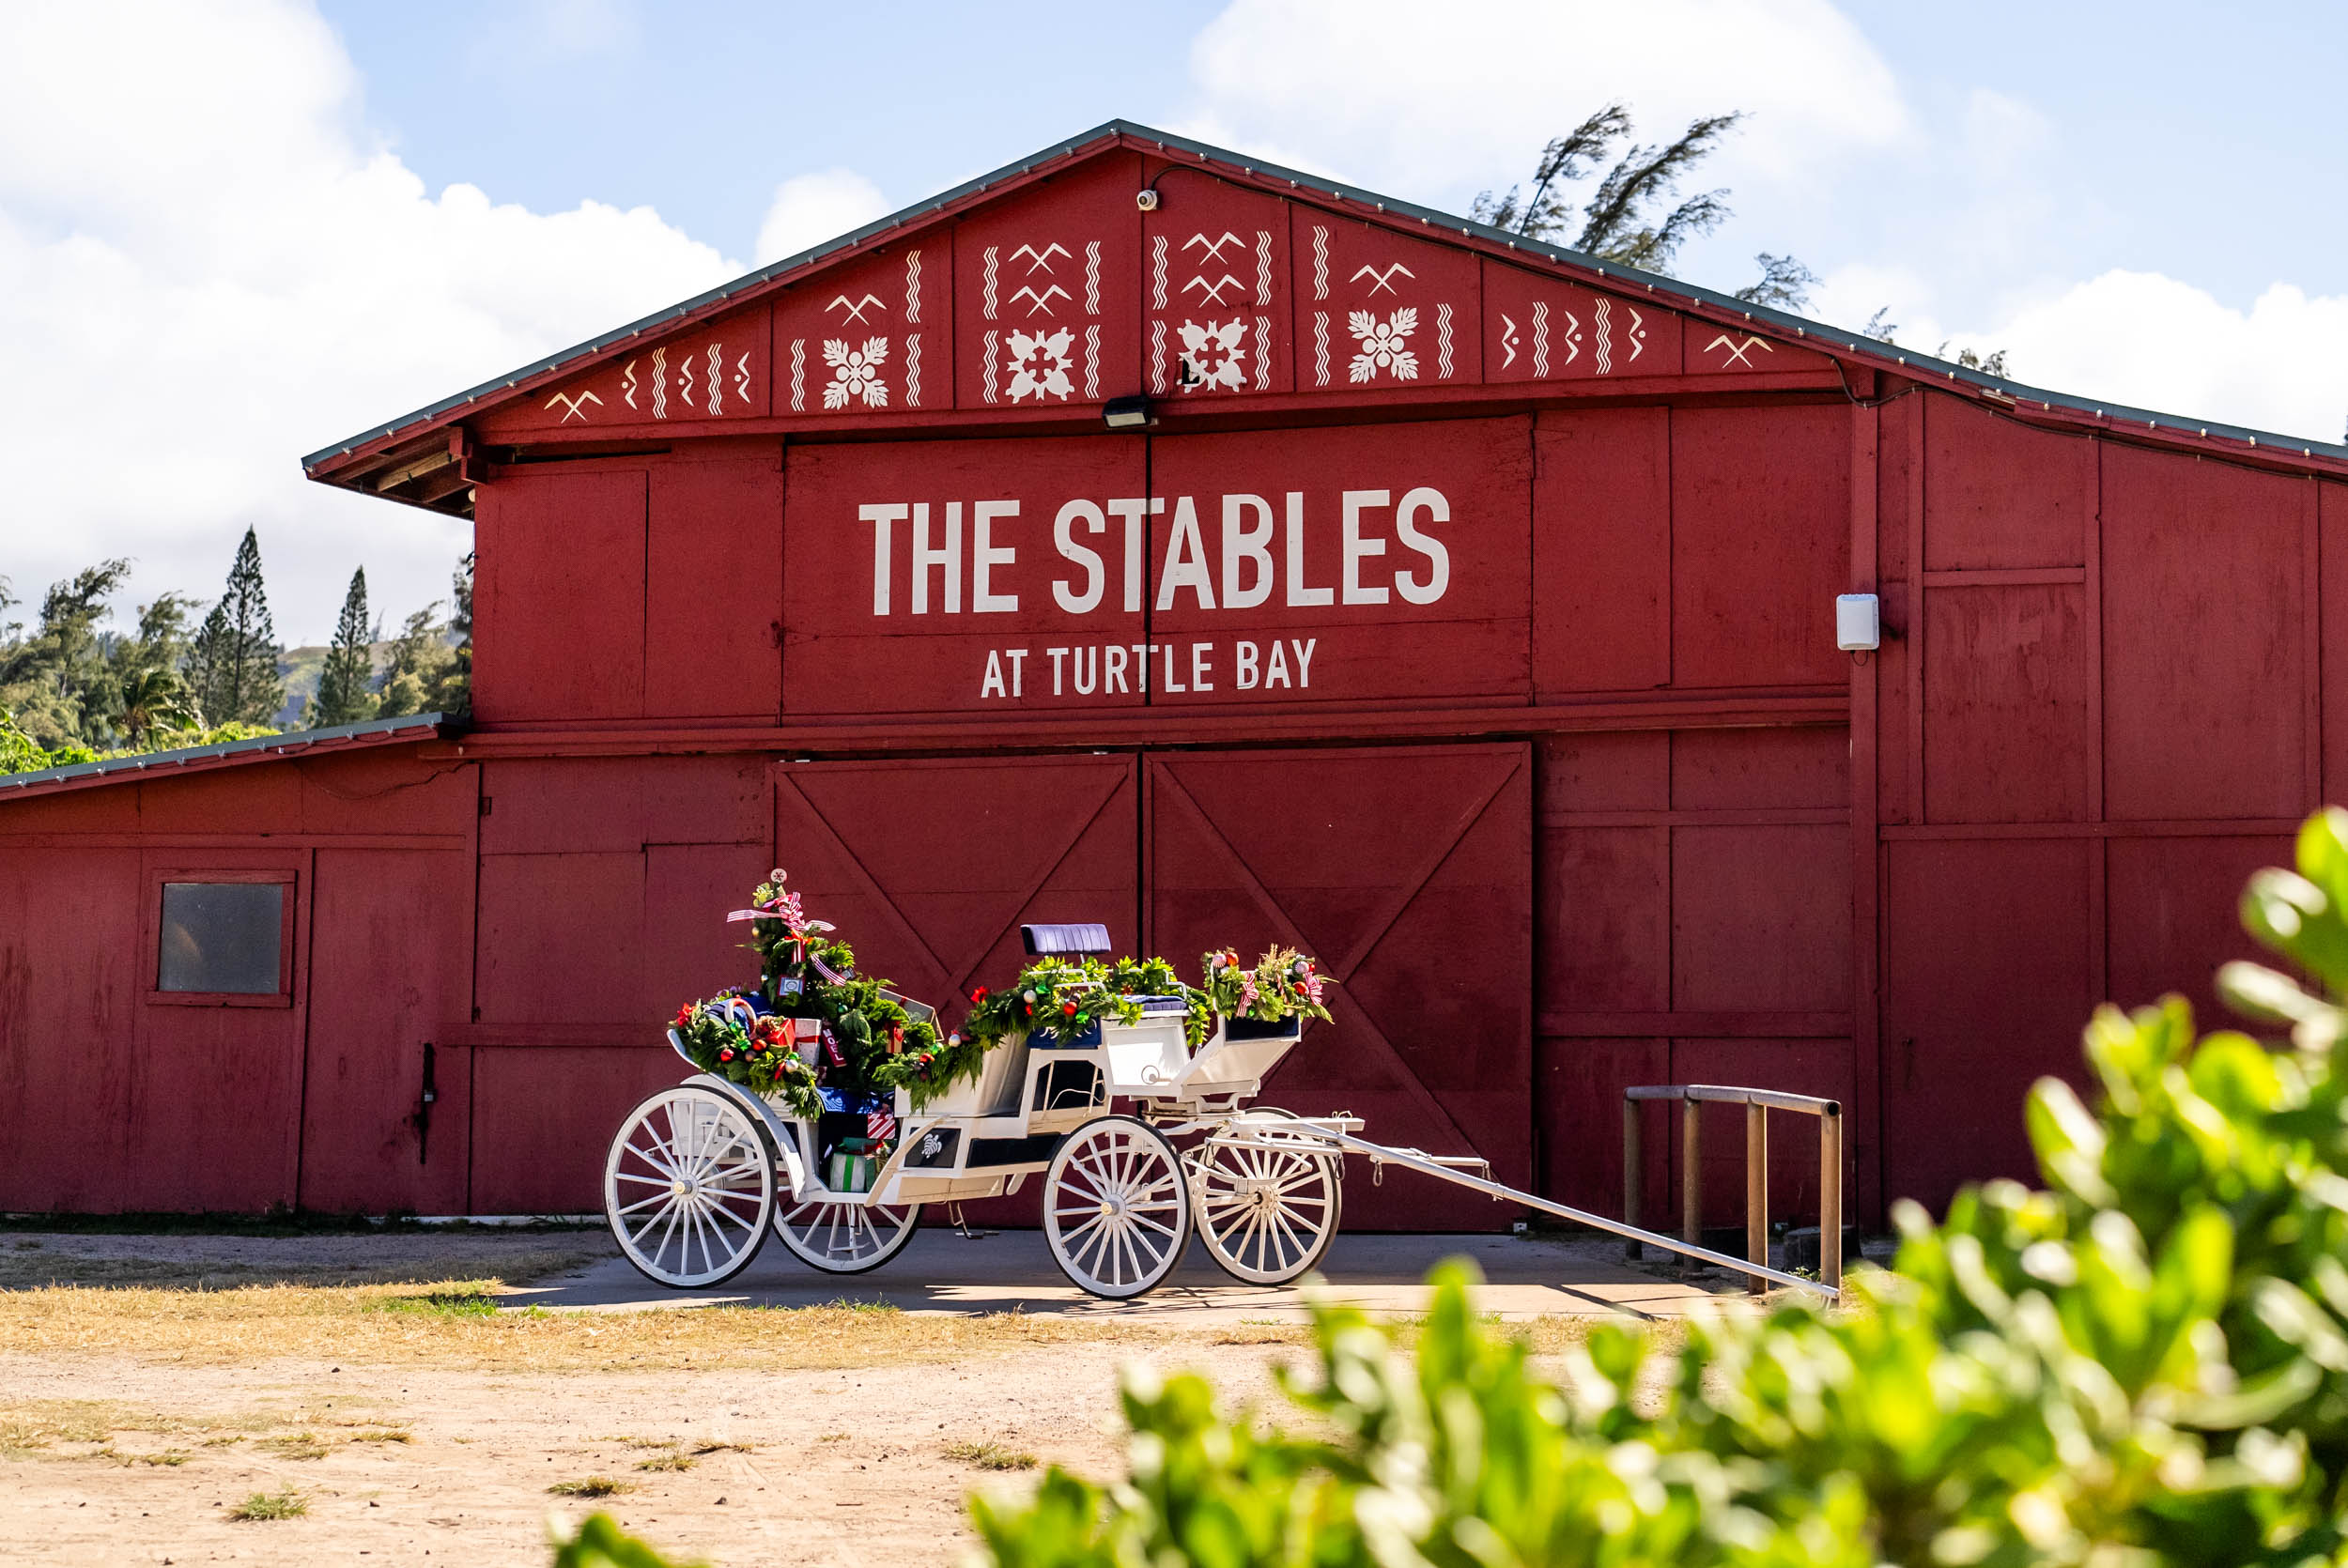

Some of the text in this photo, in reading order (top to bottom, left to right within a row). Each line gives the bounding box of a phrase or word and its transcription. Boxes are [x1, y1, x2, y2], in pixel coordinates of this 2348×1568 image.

[858, 486, 1451, 616] THE STABLES
[981, 638, 1317, 699] AT TURTLE BAY
[823, 1028, 844, 1061] NOEL
